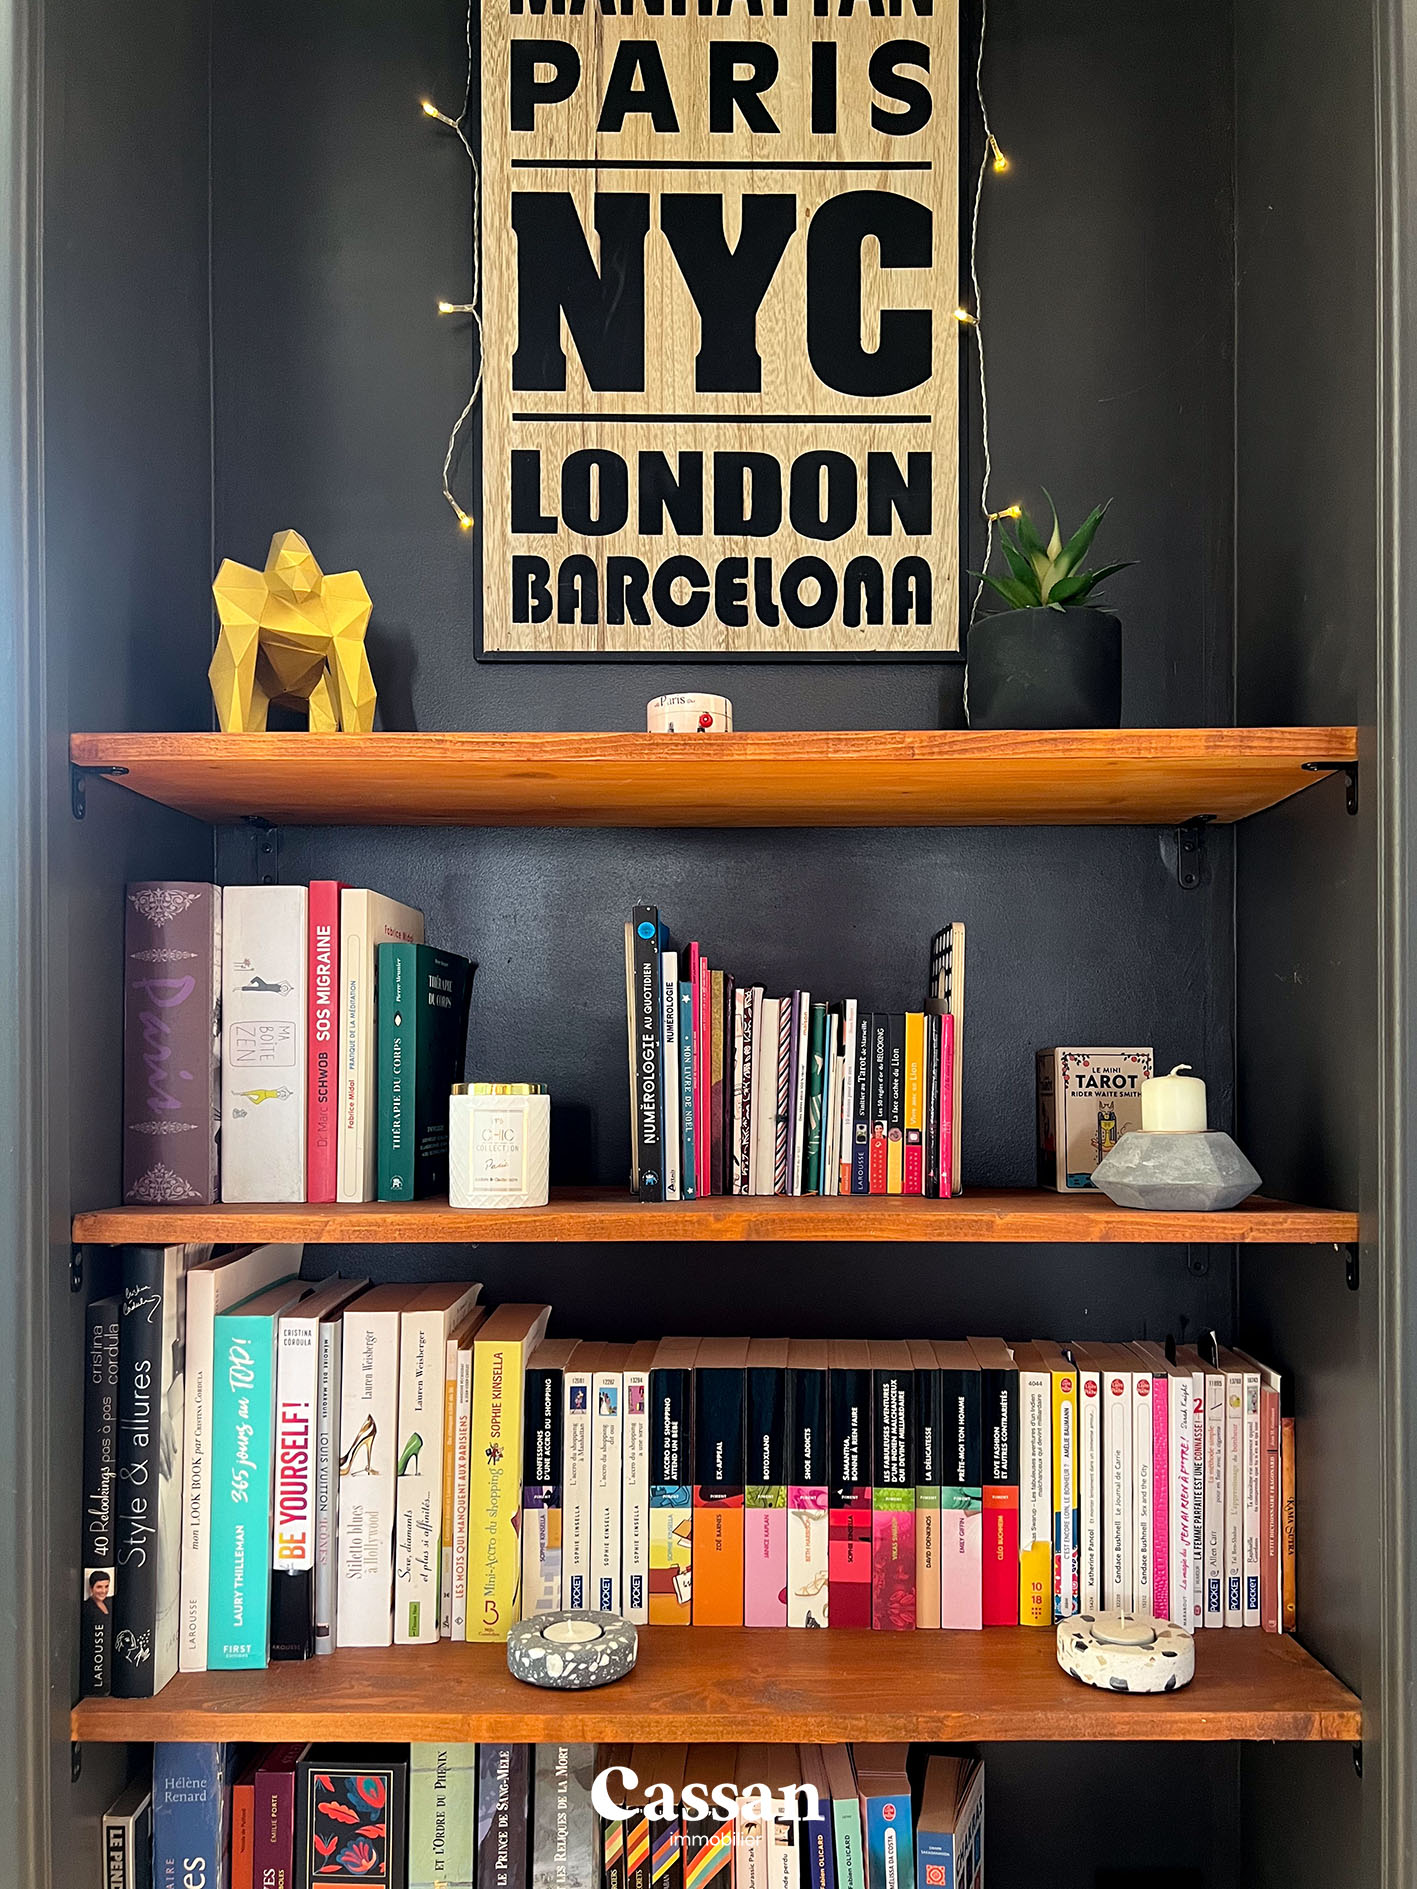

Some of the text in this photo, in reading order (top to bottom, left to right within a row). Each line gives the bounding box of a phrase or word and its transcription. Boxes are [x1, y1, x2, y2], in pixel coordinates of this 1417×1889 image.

[510, 39, 933, 136] PARIS
[511, 190, 933, 397] NYC
[511, 449, 933, 541] LONDON
[511, 554, 933, 628] BARCELONA
[316, 925, 331, 1041] SOS MIGRAINE
[643, 963, 653, 1014] QUOTIDIEN
[279, 1025, 290, 1041] MA
[347, 980, 357, 1070] PRATIQUE MÉDITATION
[644, 1016, 653, 1030] AU
[664, 981, 674, 1043] NUMÉROLOGIE
[236, 1026, 256, 1061] ZEN
[317, 1052, 328, 1133] Marc SCHWOB
[857, 1057, 867, 1083] Tarot
[891, 1048, 899, 1123] La face cachée du Lion
[1075, 1074, 1139, 1089] TAROT
[347, 1102, 356, 1129] Fabrice
[390, 1038, 402, 1150] THÉRAPIE DU CORPS
[858, 1093, 867, 1116] S'initier
[857, 1152, 865, 1190] LAROUSSE
[90, 1325, 103, 1384] cristina
[106, 1323, 120, 1386] cordula
[283, 1329, 312, 1337] CRISTINA
[361, 1330, 377, 1400] Lauren Weisberger
[414, 1330, 426, 1411] Lauren Weisberger
[237, 1397, 251, 1420] au
[490, 1352, 503, 1438] SOPHIE KINSELLA
[1000, 1390, 1008, 1442] CONTRARIÉTÉS
[232, 1422, 257, 1470] jours
[457, 1415, 467, 1461] PARISIENS
[544, 1418, 551, 1429] DU
[663, 1397, 671, 1480] L'ACCRO DU SHOPPING
[118, 1360, 156, 1568] Style & allures
[536, 1430, 544, 1481] CONFESSIONS
[671, 1441, 678, 1454] UN
[843, 1436, 851, 1481] SAMANTHA,
[924, 1427, 932, 1481] LA DÉLICATESSE
[957, 1445, 965, 1482] PRÊTE-MOI
[88, 1396, 115, 1557] 40 Relookings pas pas
[231, 1471, 248, 1504] 365
[278, 1403, 310, 1560] BE YOURSELF!
[319, 1432, 329, 1512] LOUIS VUITTON
[457, 1463, 467, 1480] AUX
[1001, 1471, 1008, 1479] ET
[1140, 1464, 1149, 1477] City
[1193, 1424, 1202, 1550] FEMME PARFAITE UNE CONNASSE
[190, 1438, 204, 1550] mon LOOK BOOK par
[457, 1482, 467, 1533] MANQUENT
[346, 1505, 364, 1580] Stiletto blues
[364, 1511, 381, 1566] Hollywood
[399, 1509, 414, 1553] diamants
[455, 1535, 464, 1554] QUI
[483, 1468, 504, 1597] Mini-Accro du shopping
[1113, 1521, 1121, 1552] Bushnell
[233, 1525, 245, 1627] LAURY THILLEMAN
[419, 1551, 431, 1571] plus
[455, 1556, 464, 1582] MOTS
[1113, 1553, 1121, 1584] Candace
[1209, 1531, 1219, 1612] POCKET Allen Carr
[455, 1584, 464, 1599] LES
[572, 1576, 582, 1609] POCKET
[601, 1578, 611, 1611] POCKET
[631, 1575, 642, 1609] POCKET
[1031, 1582, 1043, 1592] 10
[1031, 1595, 1043, 1605] 18
[1230, 1577, 1239, 1610] POCKET
[187, 1599, 198, 1650] LAROUSSE
[93, 1624, 104, 1687] LAROUSSE
[223, 1645, 252, 1654] FIRST
[165, 1776, 207, 1789] Hélène
[165, 1789, 207, 1803] Renard
[110, 1829, 123, 1847] LE
[270, 1794, 278, 1843] ÉMILIE PORTE
[183, 1857, 206, 1889] es
[817, 1834, 825, 1867] OLICARD
